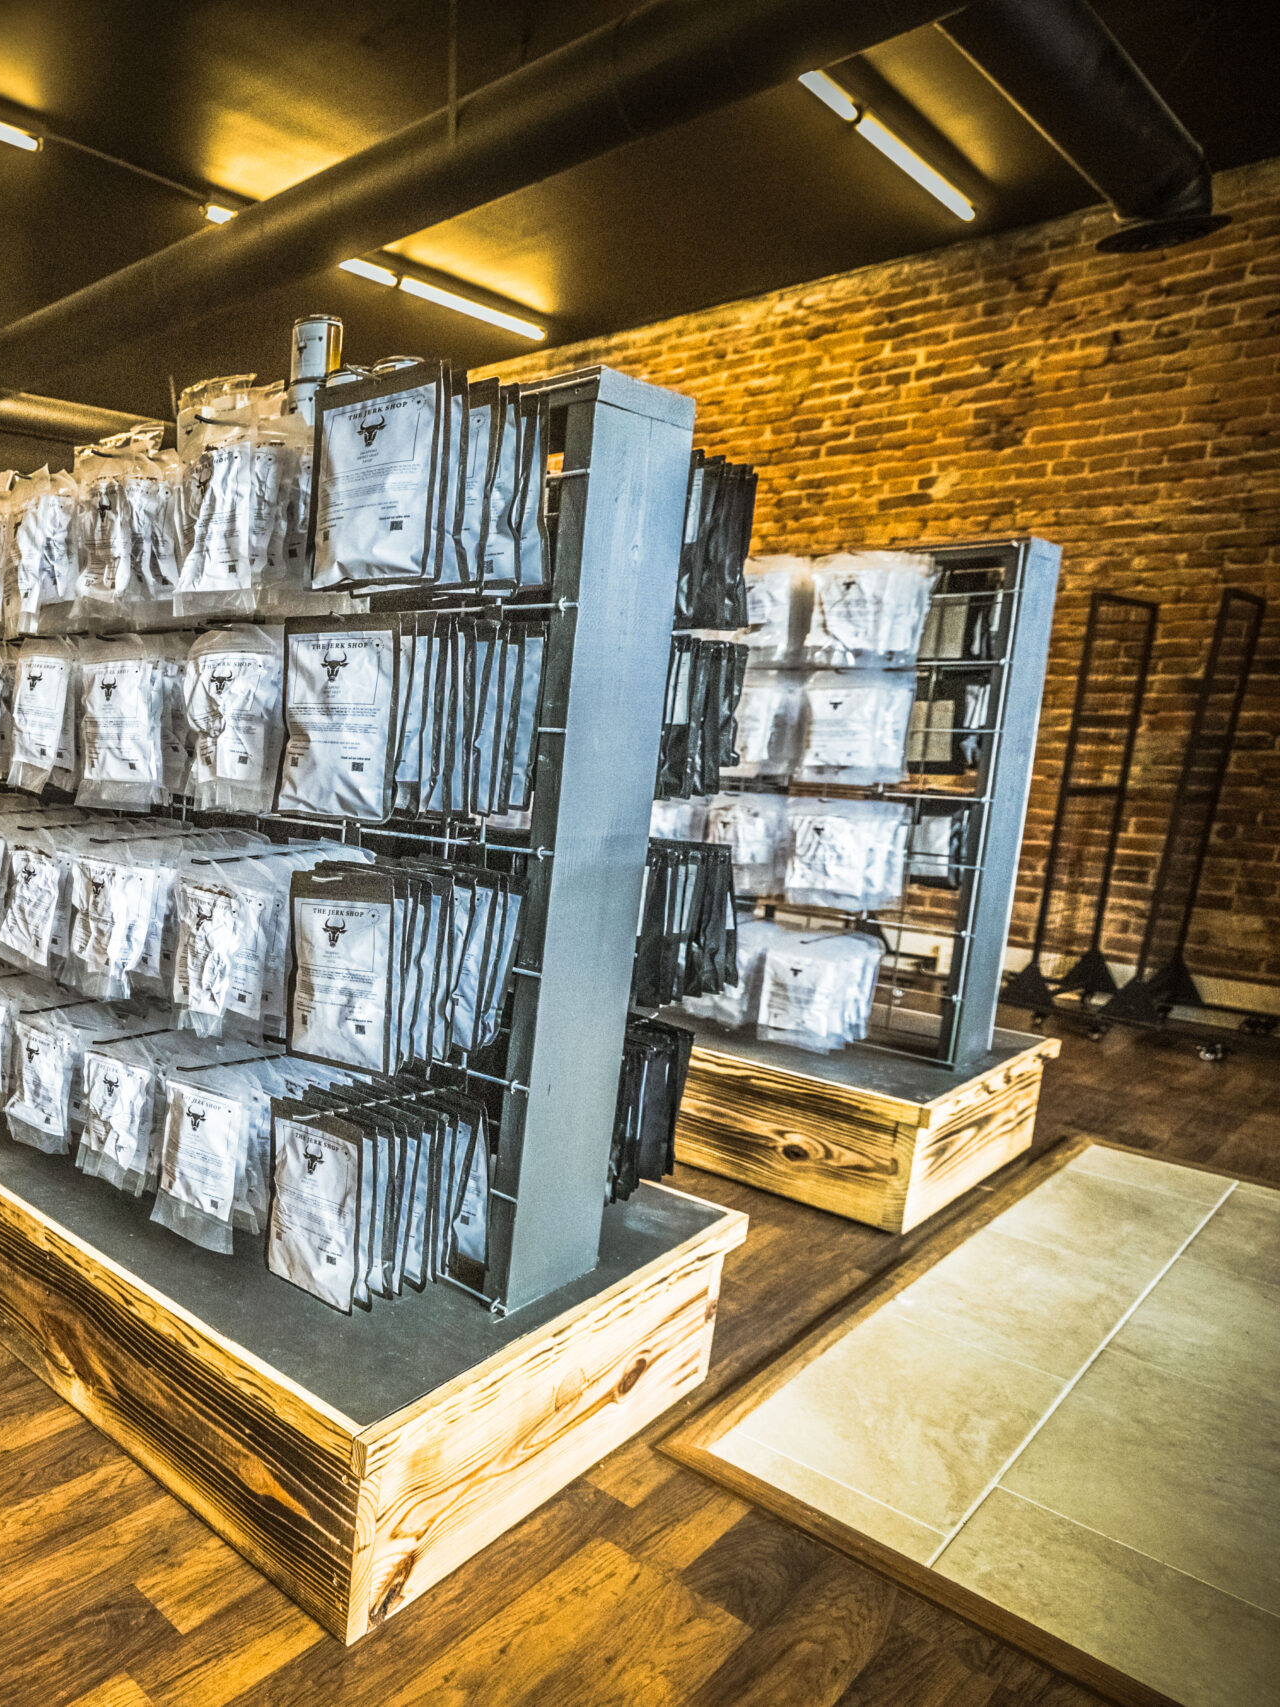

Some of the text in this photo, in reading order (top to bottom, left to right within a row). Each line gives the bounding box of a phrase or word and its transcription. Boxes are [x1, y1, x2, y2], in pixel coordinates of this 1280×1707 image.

[347, 402, 408, 421] THE JERK SHOP
[326, 642, 346, 651] JERK
[295, 1132, 340, 1152] THE JERK SHOP
